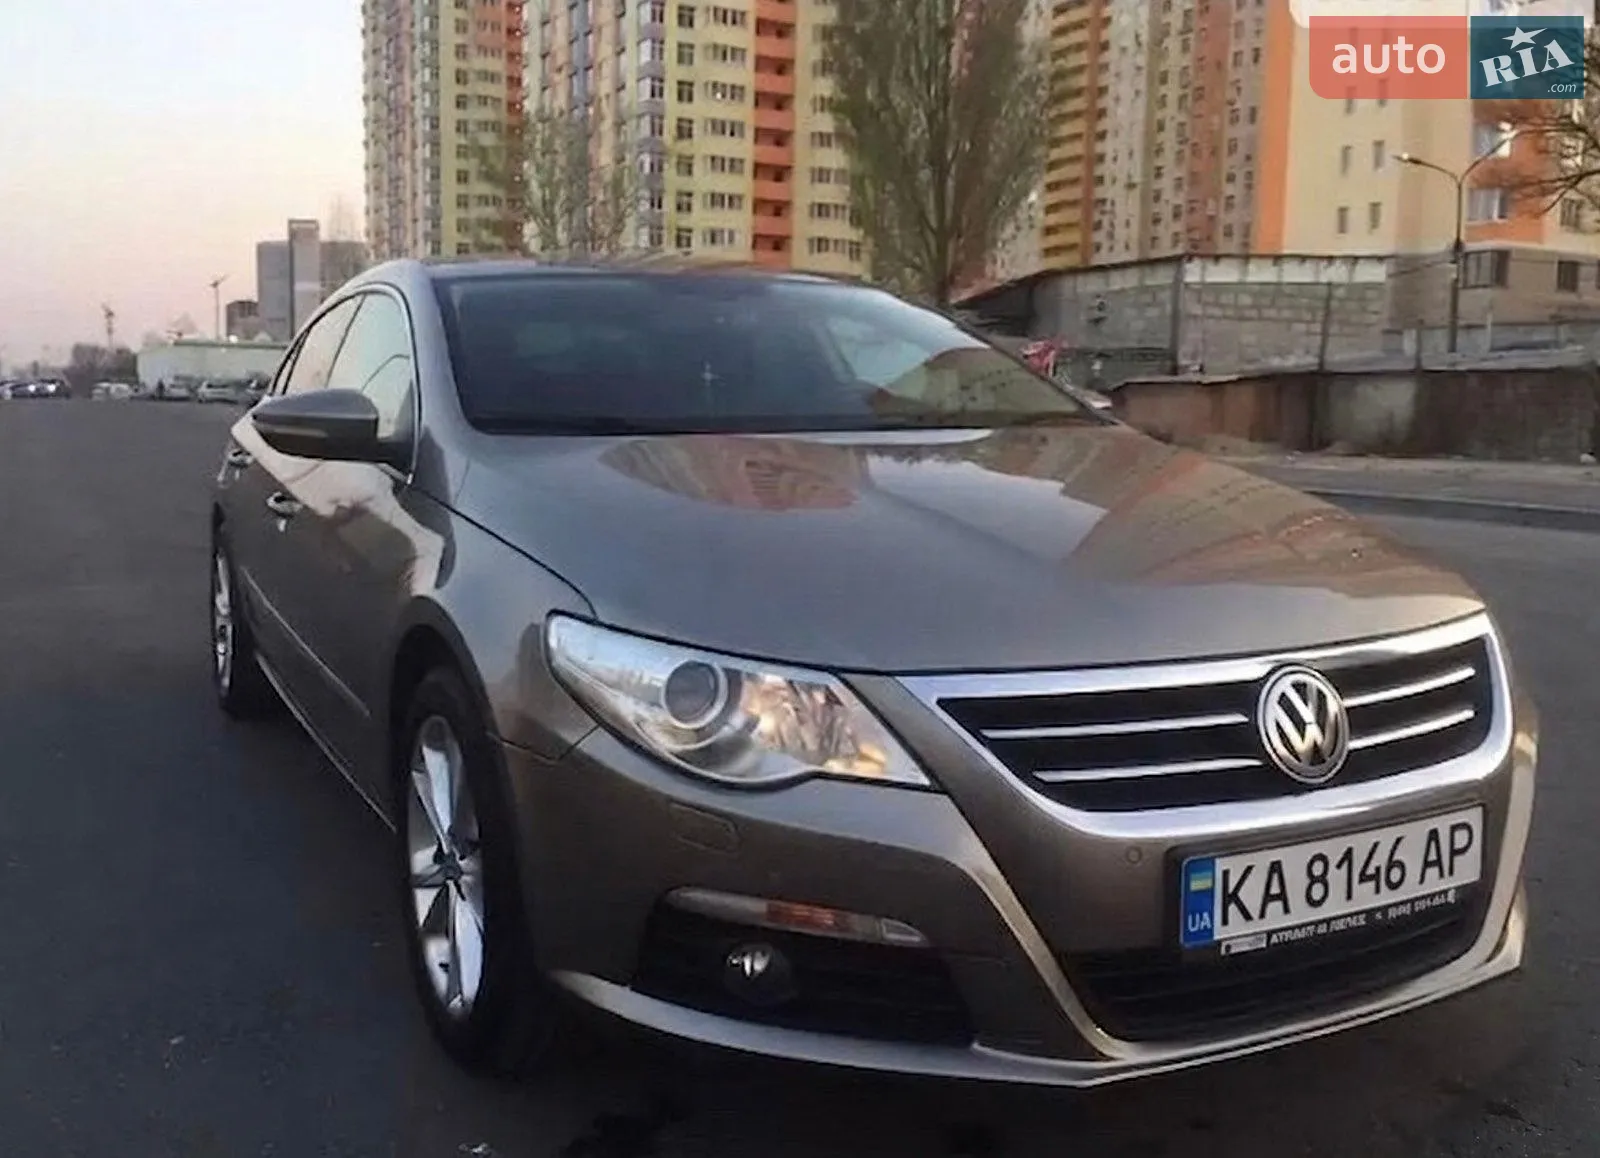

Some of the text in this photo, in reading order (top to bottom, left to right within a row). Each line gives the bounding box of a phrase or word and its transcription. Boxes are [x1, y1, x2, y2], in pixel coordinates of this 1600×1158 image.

[1221, 821, 1474, 927] KA 8146 AP
[1188, 912, 1211, 932] UA
